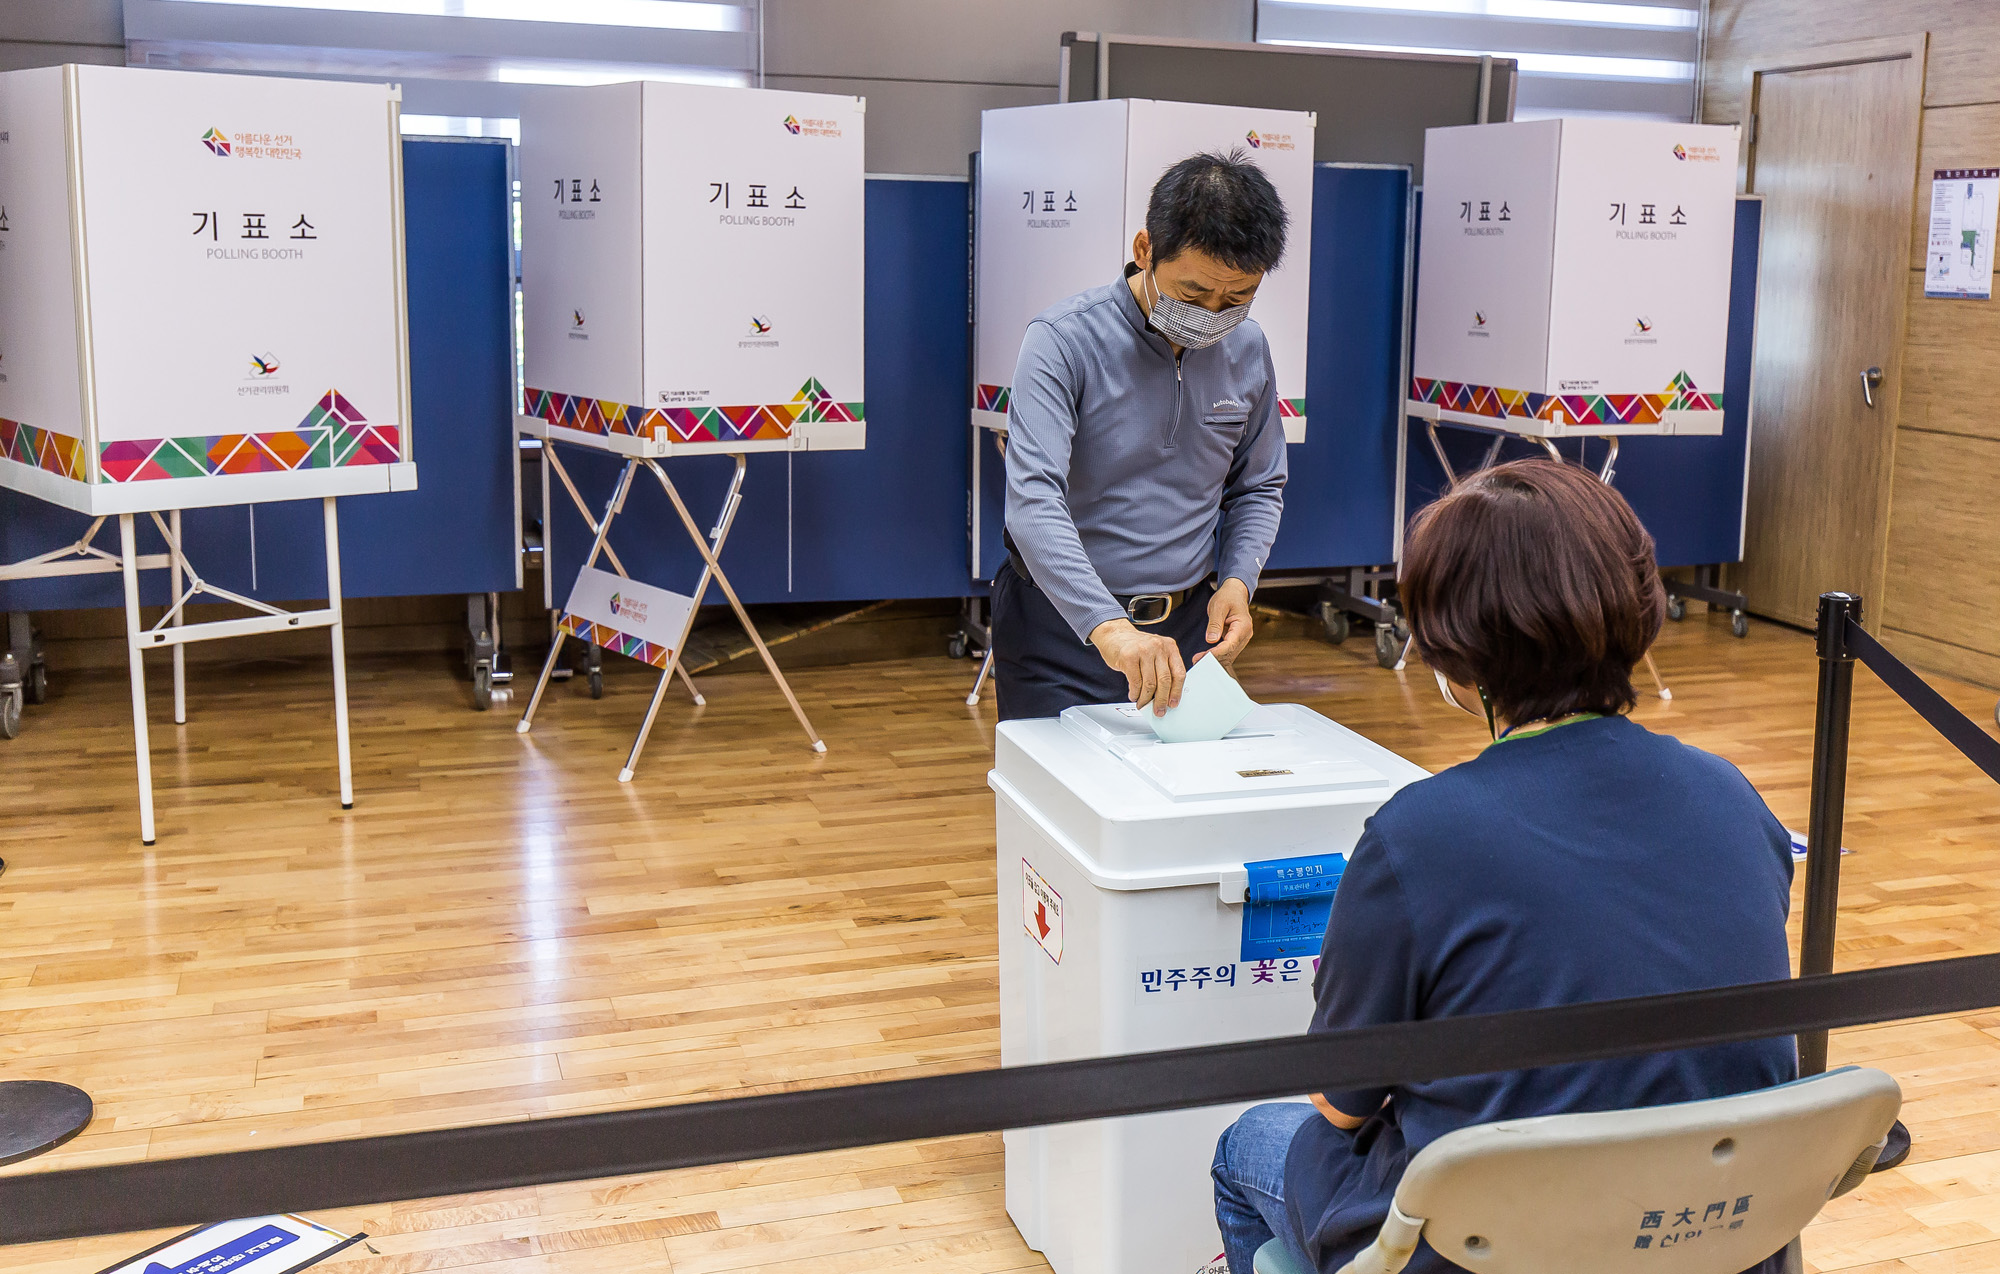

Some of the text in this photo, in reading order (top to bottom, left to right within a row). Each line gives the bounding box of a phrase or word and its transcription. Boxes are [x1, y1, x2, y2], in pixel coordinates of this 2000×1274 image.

[234, 133, 293, 146] 아름다운 선거
[235, 146, 302, 160] 행복한 대한민국
[719, 214, 795, 227] POLLING BOOTH
[1616, 230, 1677, 241] POLLING BOOTH
[206, 248, 303, 260] POLLING BOOTH
[1277, 864, 1323, 879] 특수봉인지
[1140, 959, 1302, 993] 민주주의 꽃은
[1640, 1194, 1753, 1229] 西大門區
